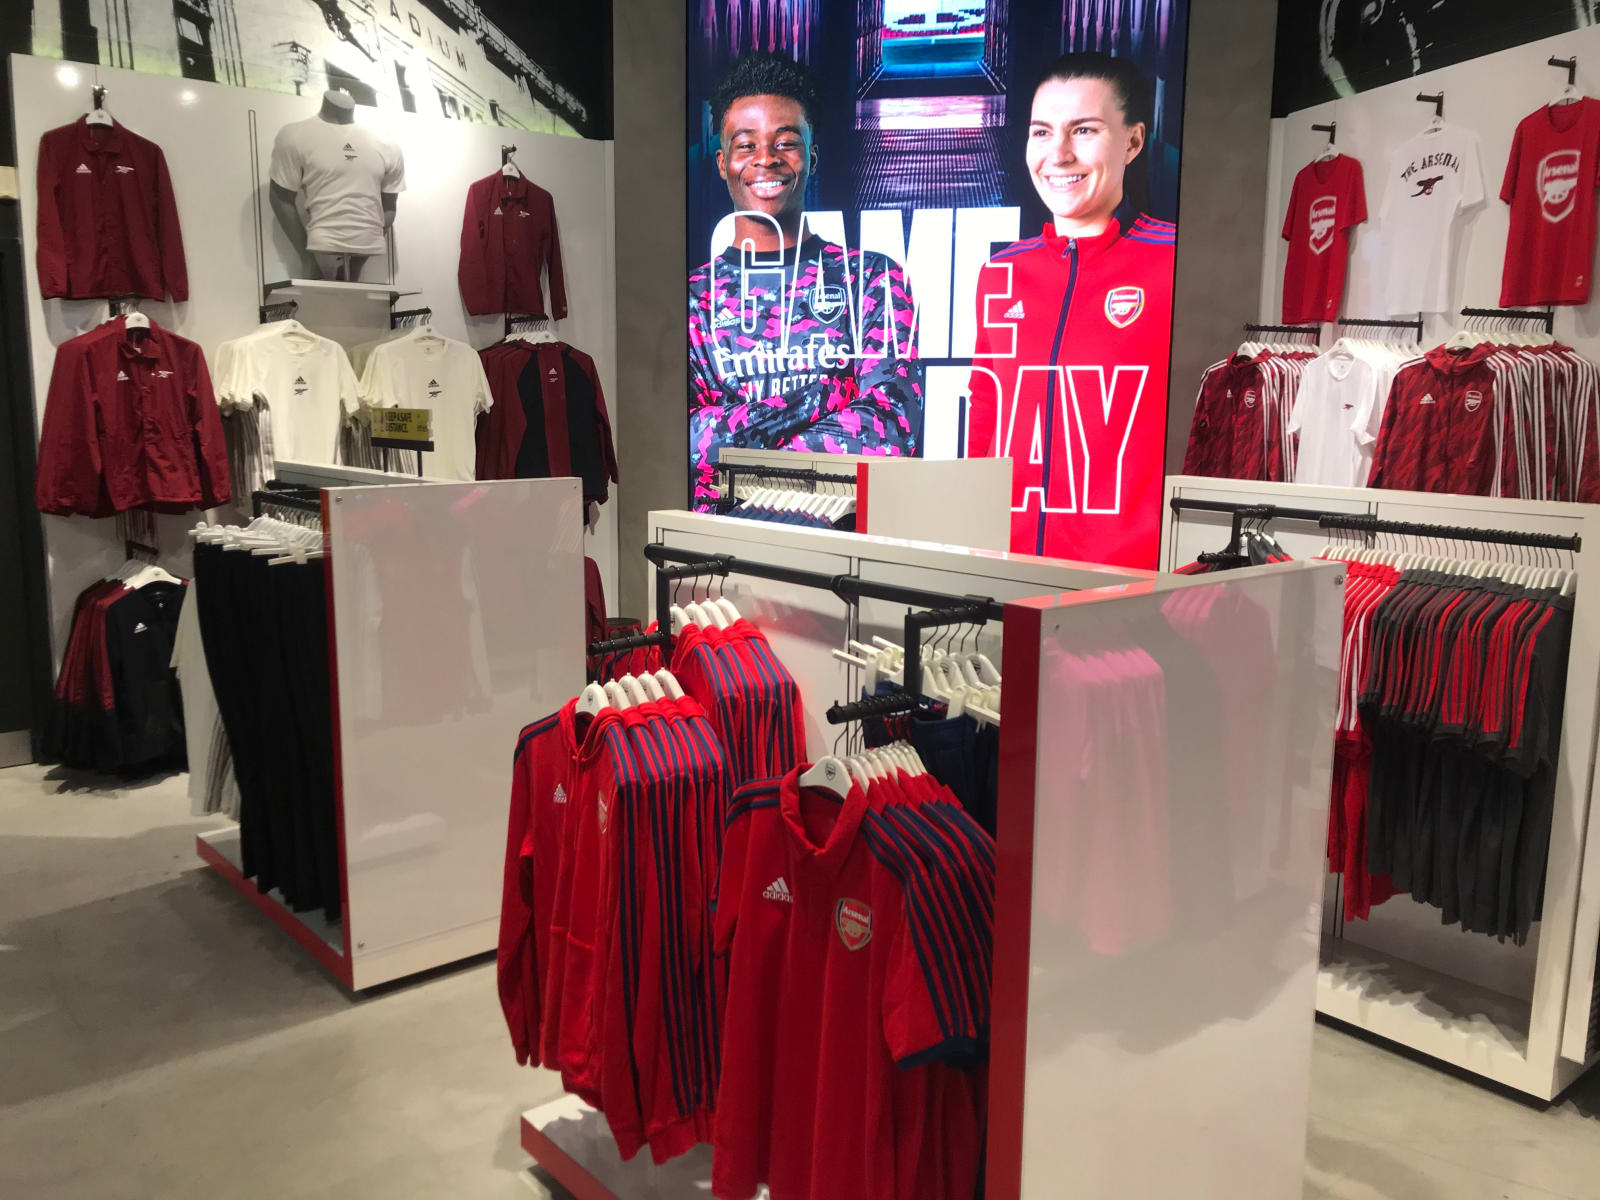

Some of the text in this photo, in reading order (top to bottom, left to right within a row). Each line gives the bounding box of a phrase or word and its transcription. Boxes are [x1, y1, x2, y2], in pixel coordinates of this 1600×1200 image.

[1400, 160, 1418, 182] THE
[710, 206, 1021, 360] GAME
[923, 365, 1149, 515] DAY
[762, 890, 793, 903] adidas
[842, 905, 870, 924] Arsenal
